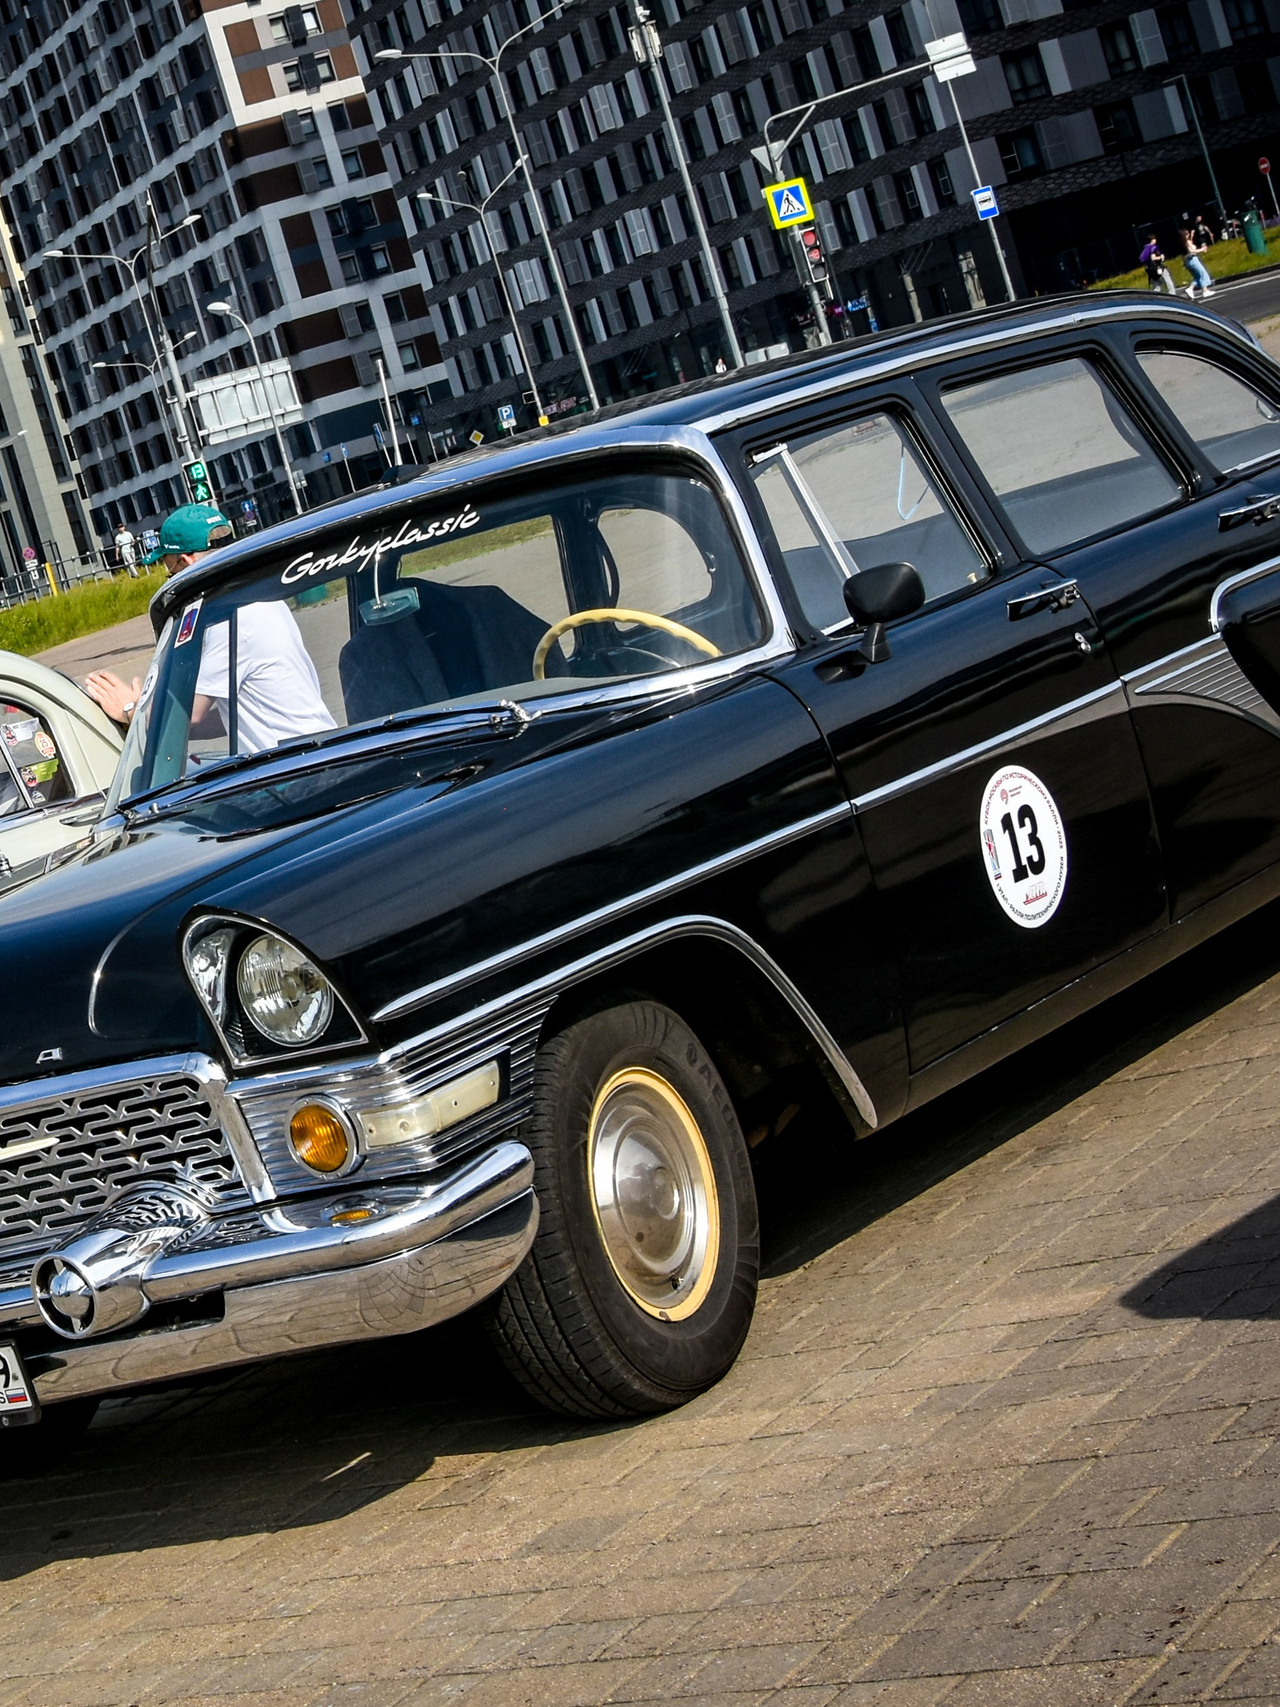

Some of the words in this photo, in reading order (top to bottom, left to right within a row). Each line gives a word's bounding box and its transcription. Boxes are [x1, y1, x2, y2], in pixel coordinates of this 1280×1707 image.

[502, 407, 511, 420] P
[191, 463, 204, 479] 13
[280, 504, 480, 584] Gorkyclassic
[1000, 803, 1046, 884] 13
